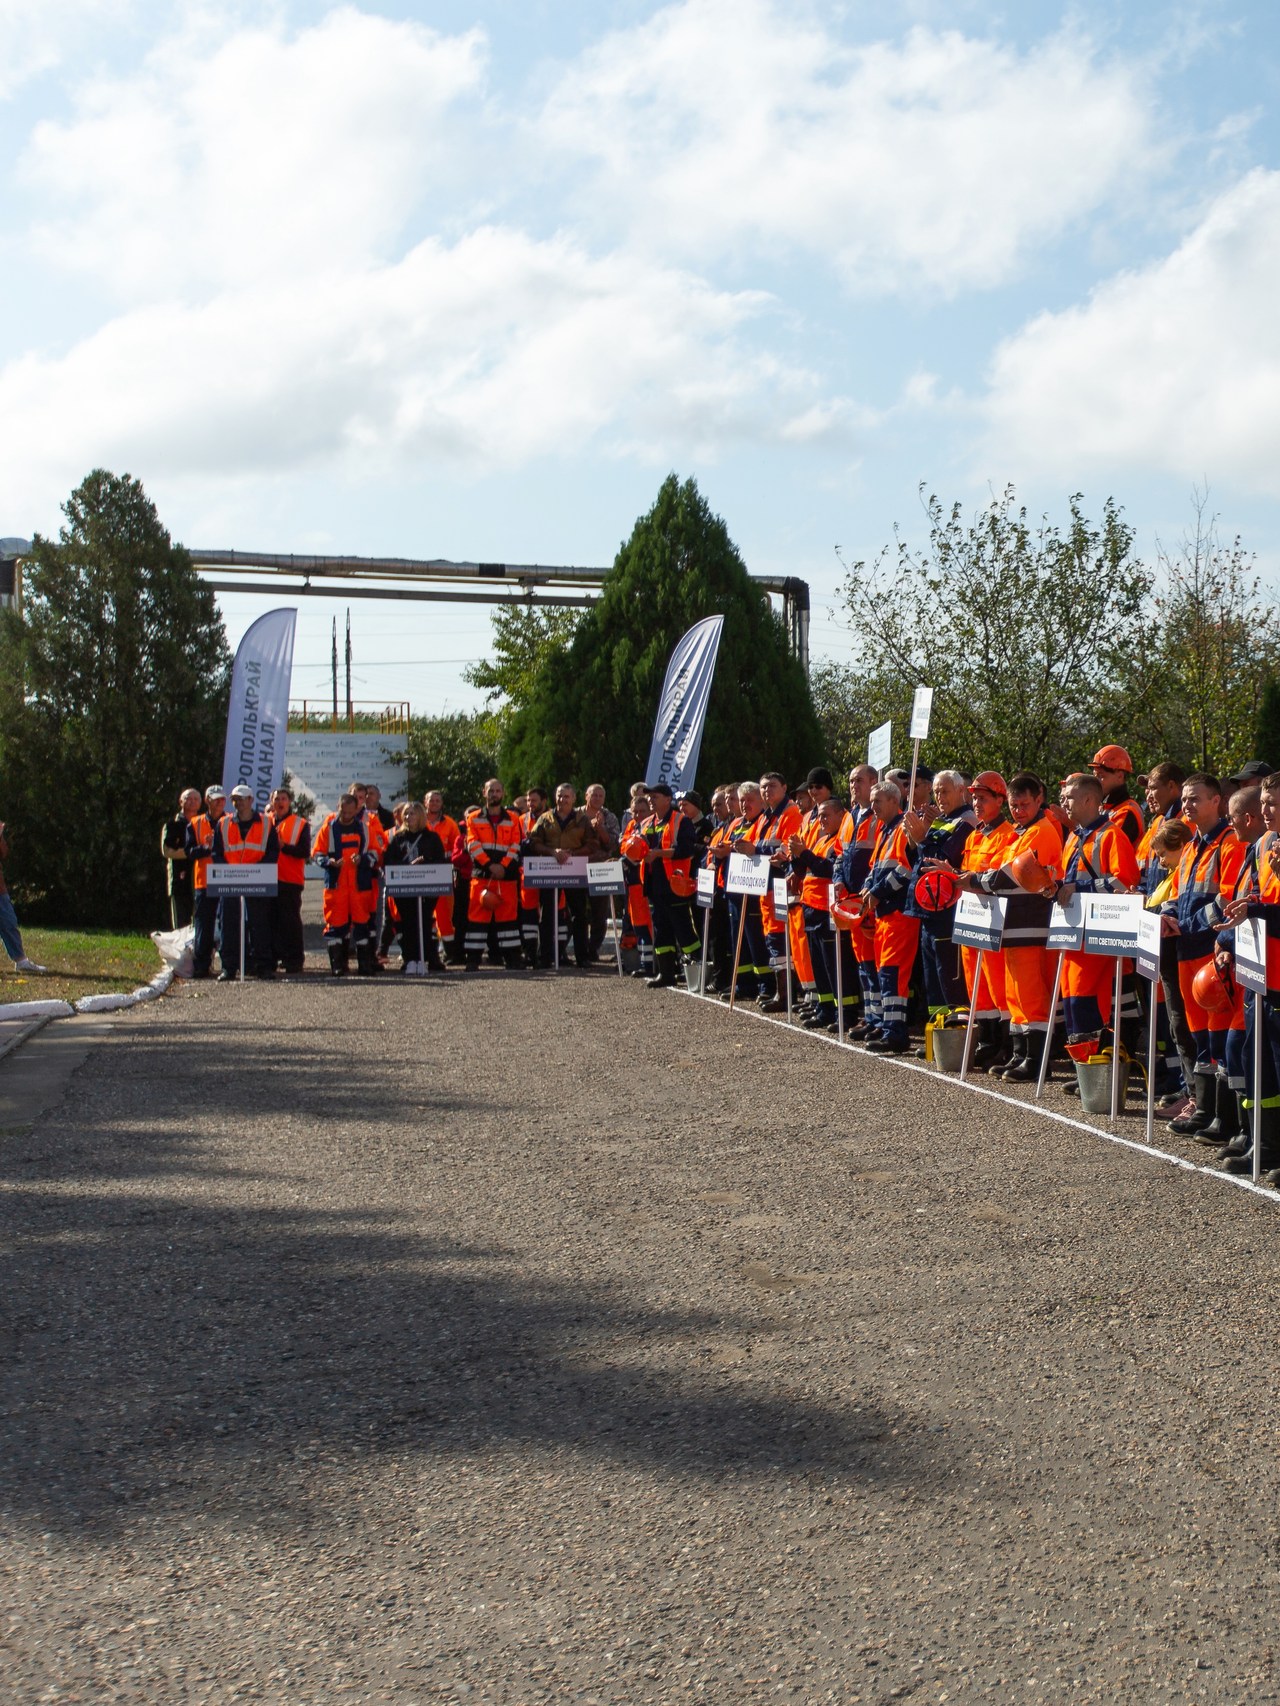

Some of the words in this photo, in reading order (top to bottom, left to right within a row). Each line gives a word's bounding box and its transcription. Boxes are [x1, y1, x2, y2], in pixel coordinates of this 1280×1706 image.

[238, 661, 261, 788] РОПОЛЬКРАЙ
[658, 668, 690, 785] РОПОЛЬКРАЙ
[742, 859, 753, 873] ПТП
[729, 871, 766, 889] Кисловодское
[1088, 937, 1098, 945] ПТП
